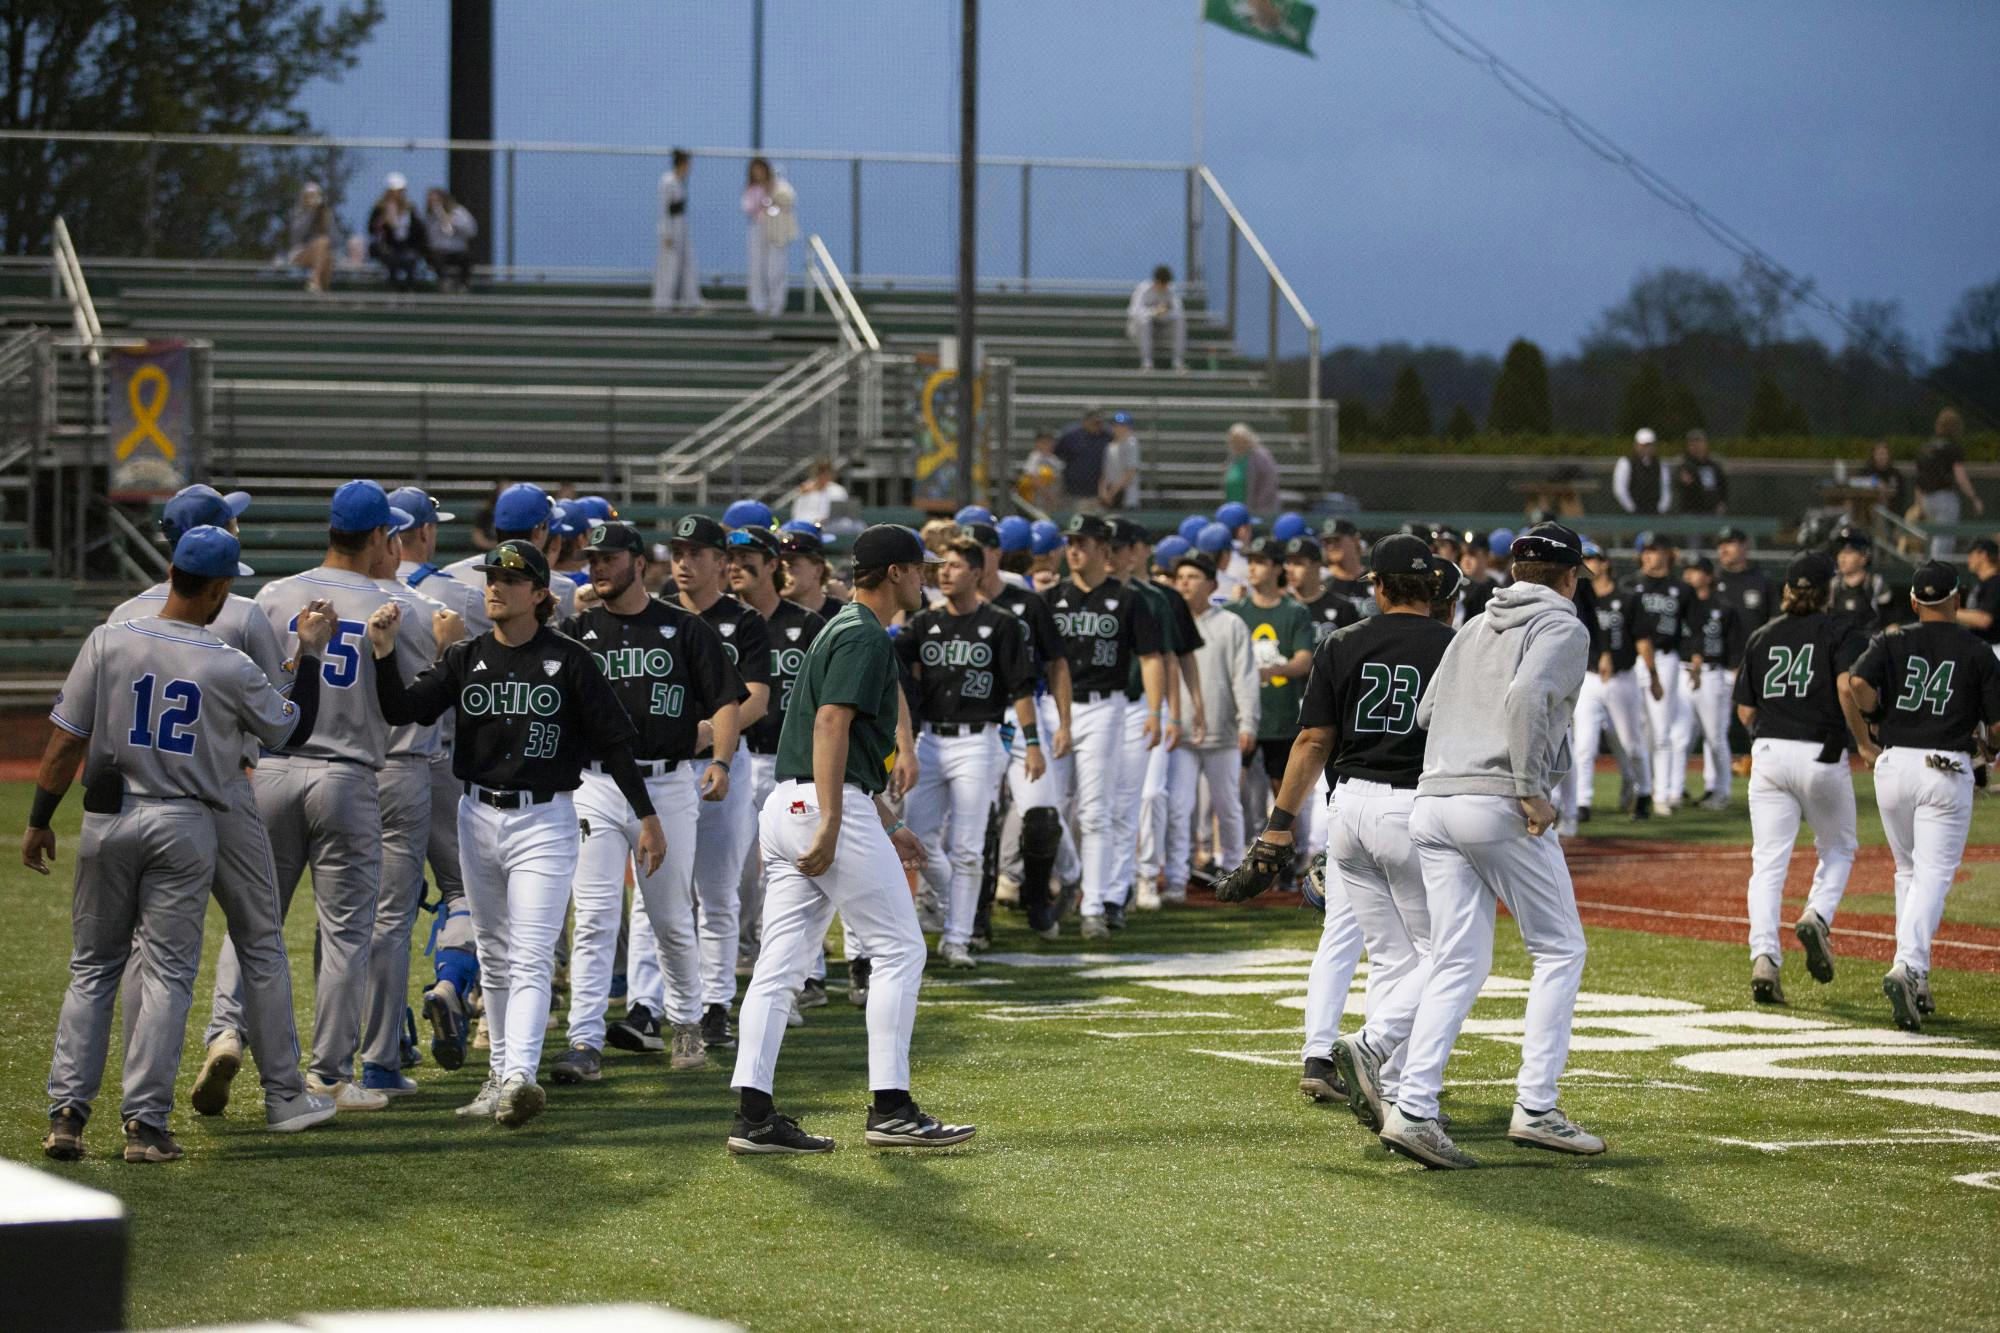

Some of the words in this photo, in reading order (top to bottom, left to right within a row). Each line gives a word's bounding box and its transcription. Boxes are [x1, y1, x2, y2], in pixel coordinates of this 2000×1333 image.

[920, 639, 992, 667] OHIO
[1763, 644, 1814, 699] 24
[461, 682, 561, 716] OHIO
[650, 682, 685, 718] 50
[961, 669, 993, 699] 29
[1355, 663, 1420, 734] 23
[1896, 655, 1955, 715] 34
[128, 672, 203, 757] 12
[523, 721, 560, 759] 33
